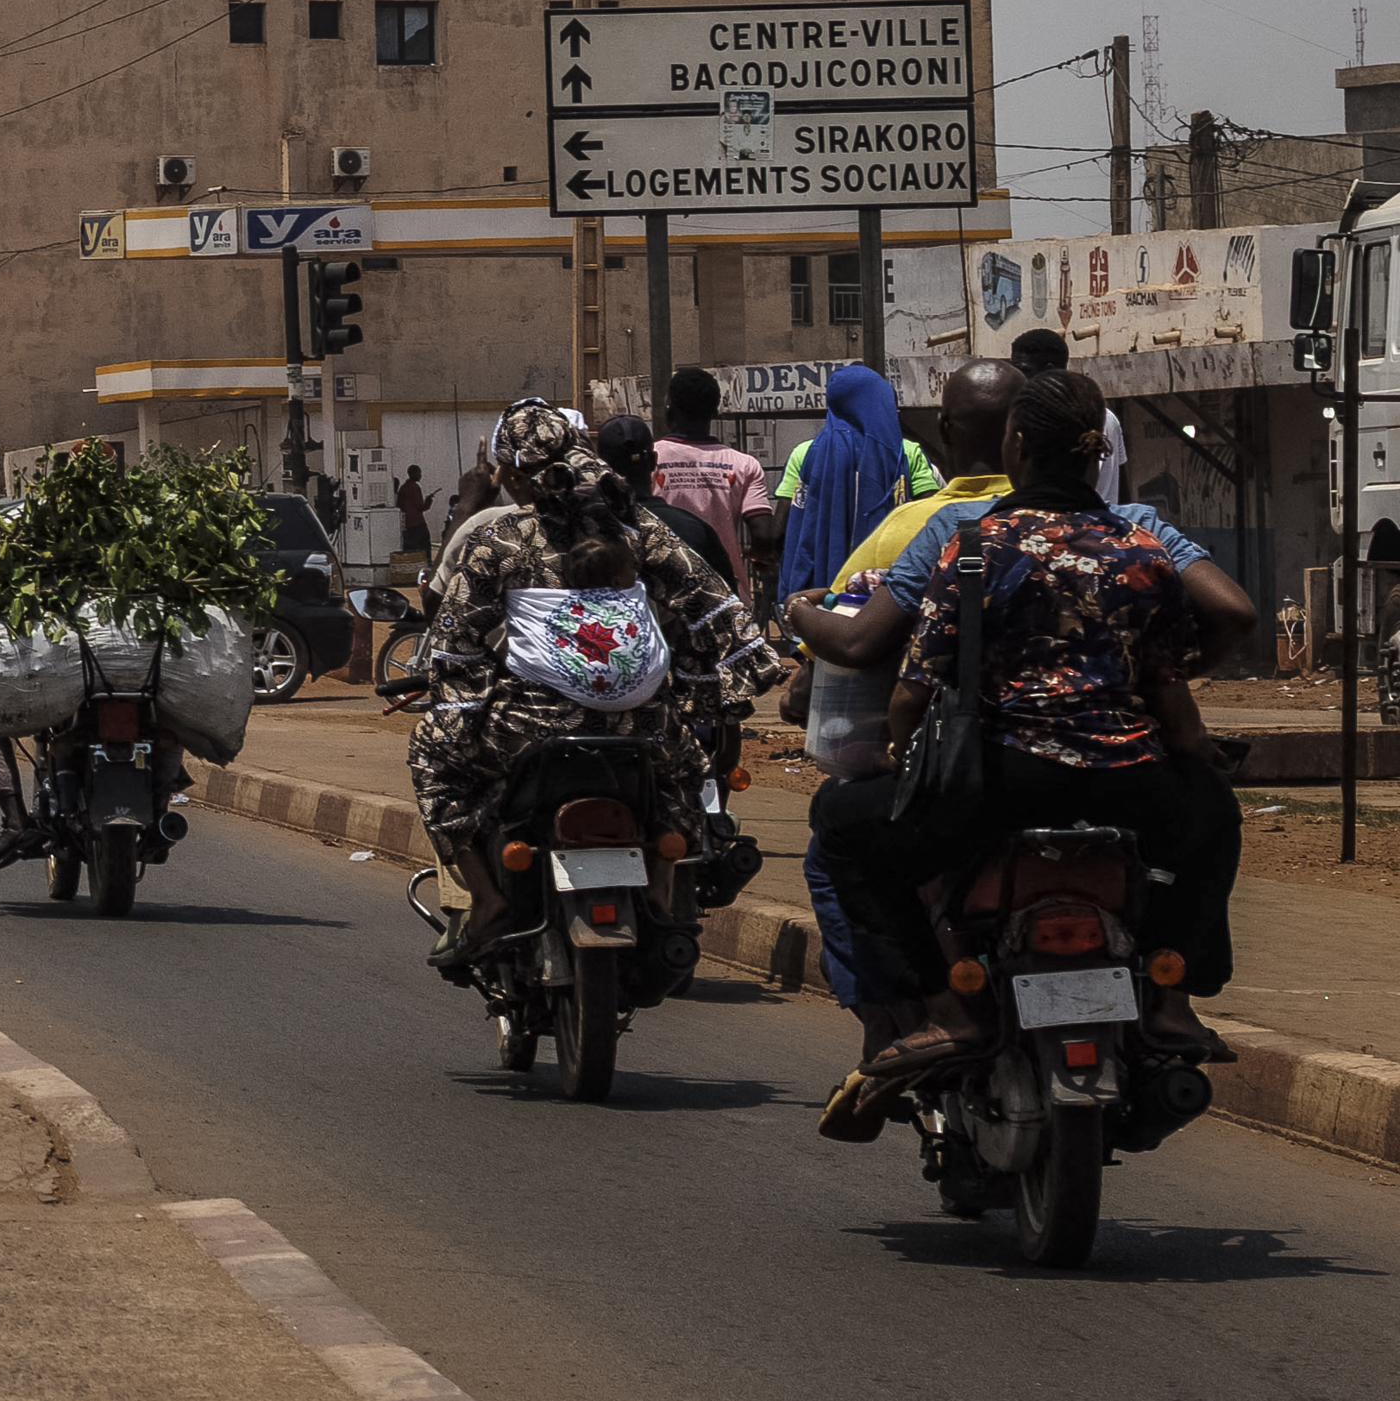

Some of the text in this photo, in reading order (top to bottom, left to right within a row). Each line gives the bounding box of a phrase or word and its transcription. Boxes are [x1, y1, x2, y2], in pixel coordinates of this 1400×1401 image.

[709, 17, 960, 52] CENTRE-VILLE
[670, 56, 962, 91] BACODJICORONI
[794, 122, 967, 155] SIRAKORO
[606, 160, 968, 199] LOGEMENTS SOCIAUX
[748, 397, 785, 411] AUTO
